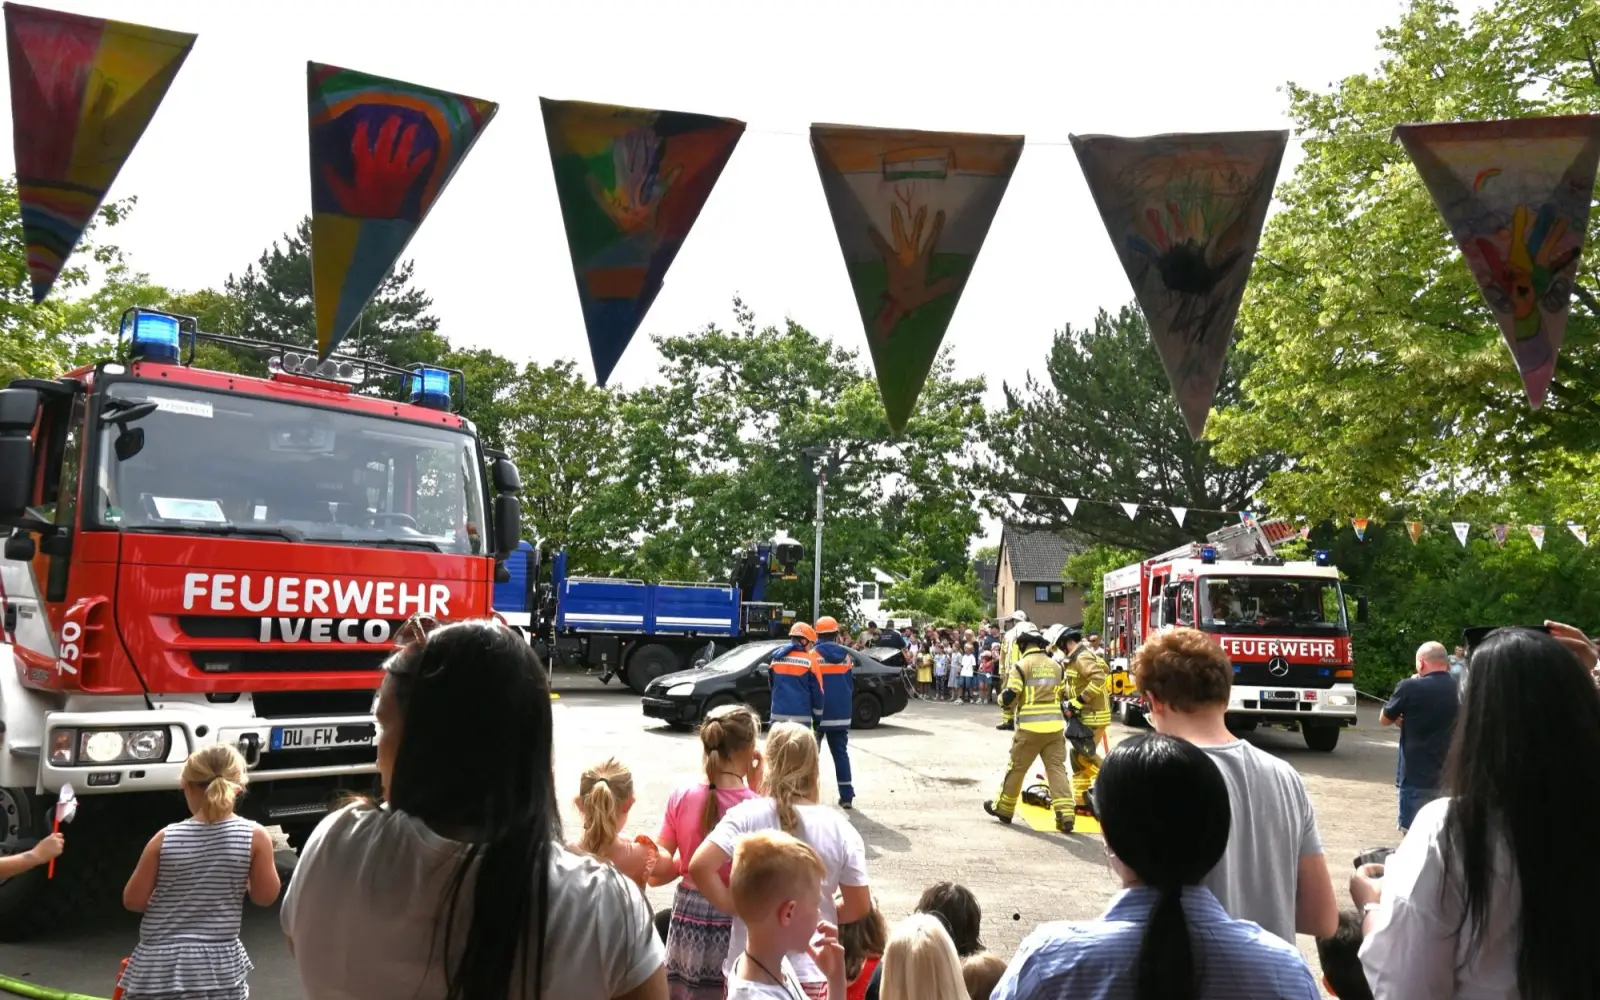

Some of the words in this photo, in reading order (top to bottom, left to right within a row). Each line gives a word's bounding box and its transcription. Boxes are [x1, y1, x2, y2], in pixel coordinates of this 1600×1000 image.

[183, 572, 451, 616] FEUERWEHR
[259, 617, 391, 643] IVECO
[56, 621, 81, 676] 750
[1220, 637, 1336, 658] FEUERWEHR
[283, 730, 303, 747] DU
[313, 728, 333, 745] FW
